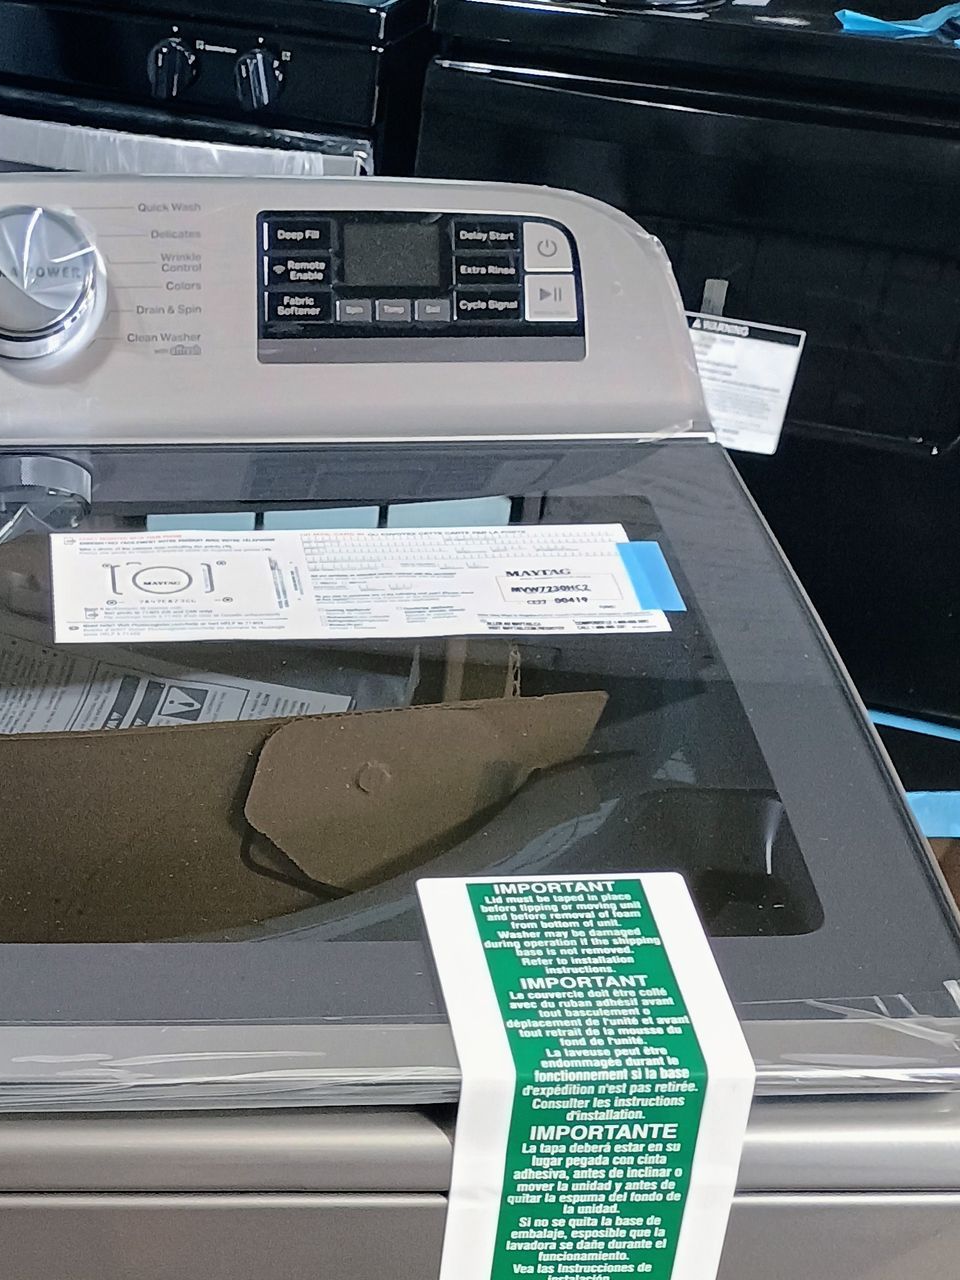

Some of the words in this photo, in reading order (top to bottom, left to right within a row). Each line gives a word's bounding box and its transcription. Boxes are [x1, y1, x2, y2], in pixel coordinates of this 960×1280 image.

[138, 203, 168, 212] Quick
[171, 203, 201, 212] Wash
[151, 230, 201, 238] Delicates
[277, 230, 301, 240] Deep
[304, 230, 320, 240] Fill
[460, 231, 487, 241] Delay
[490, 231, 514, 241] Start
[160, 253, 201, 262] Wrinkle
[161, 264, 202, 272] Control
[288, 261, 326, 271] Remote
[460, 266, 486, 275] Extra
[488, 266, 516, 275] Rinse
[290, 271, 323, 281] Enable
[166, 282, 201, 290] Colors
[284, 297, 314, 306] Fabric
[460, 300, 487, 310] Cycle
[489, 300, 517, 310] Signal
[136, 305, 165, 315] Drain
[167, 306, 175, 315] &
[177, 305, 202, 317] Spin
[277, 306, 320, 316] Softener
[127, 333, 158, 342] Clean
[160, 333, 201, 342] Washer
[505, 568, 571, 577] MAYTAG
[493, 881, 615, 894] IMPORTANT
[506, 895, 534, 903] must
[553, 894, 584, 903] taped
[601, 893, 632, 902] place
[480, 904, 517, 912] before
[520, 904, 558, 912] tipping
[576, 902, 617, 911] moving
[620, 901, 642, 909] unit
[519, 975, 648, 990] IMPORTANT
[522, 1084, 595, 1097] d'expédition
[598, 1083, 626, 1094] n'est
[629, 1084, 651, 1095] pas
[655, 1081, 698, 1093] retirée.
[532, 1098, 590, 1109] Consulter
[592, 1098, 611, 1108] les
[614, 1096, 685, 1107] instructions
[566, 1110, 646, 1121] d'installation.
[529, 1123, 679, 1141] IMPORTANTE
[522, 1143, 536, 1154] La
[539, 1143, 566, 1155] tapa
[569, 1142, 611, 1153] deberá
[614, 1143, 645, 1152] estar
[647, 1144, 663, 1152] en
[666, 1143, 681, 1152] su
